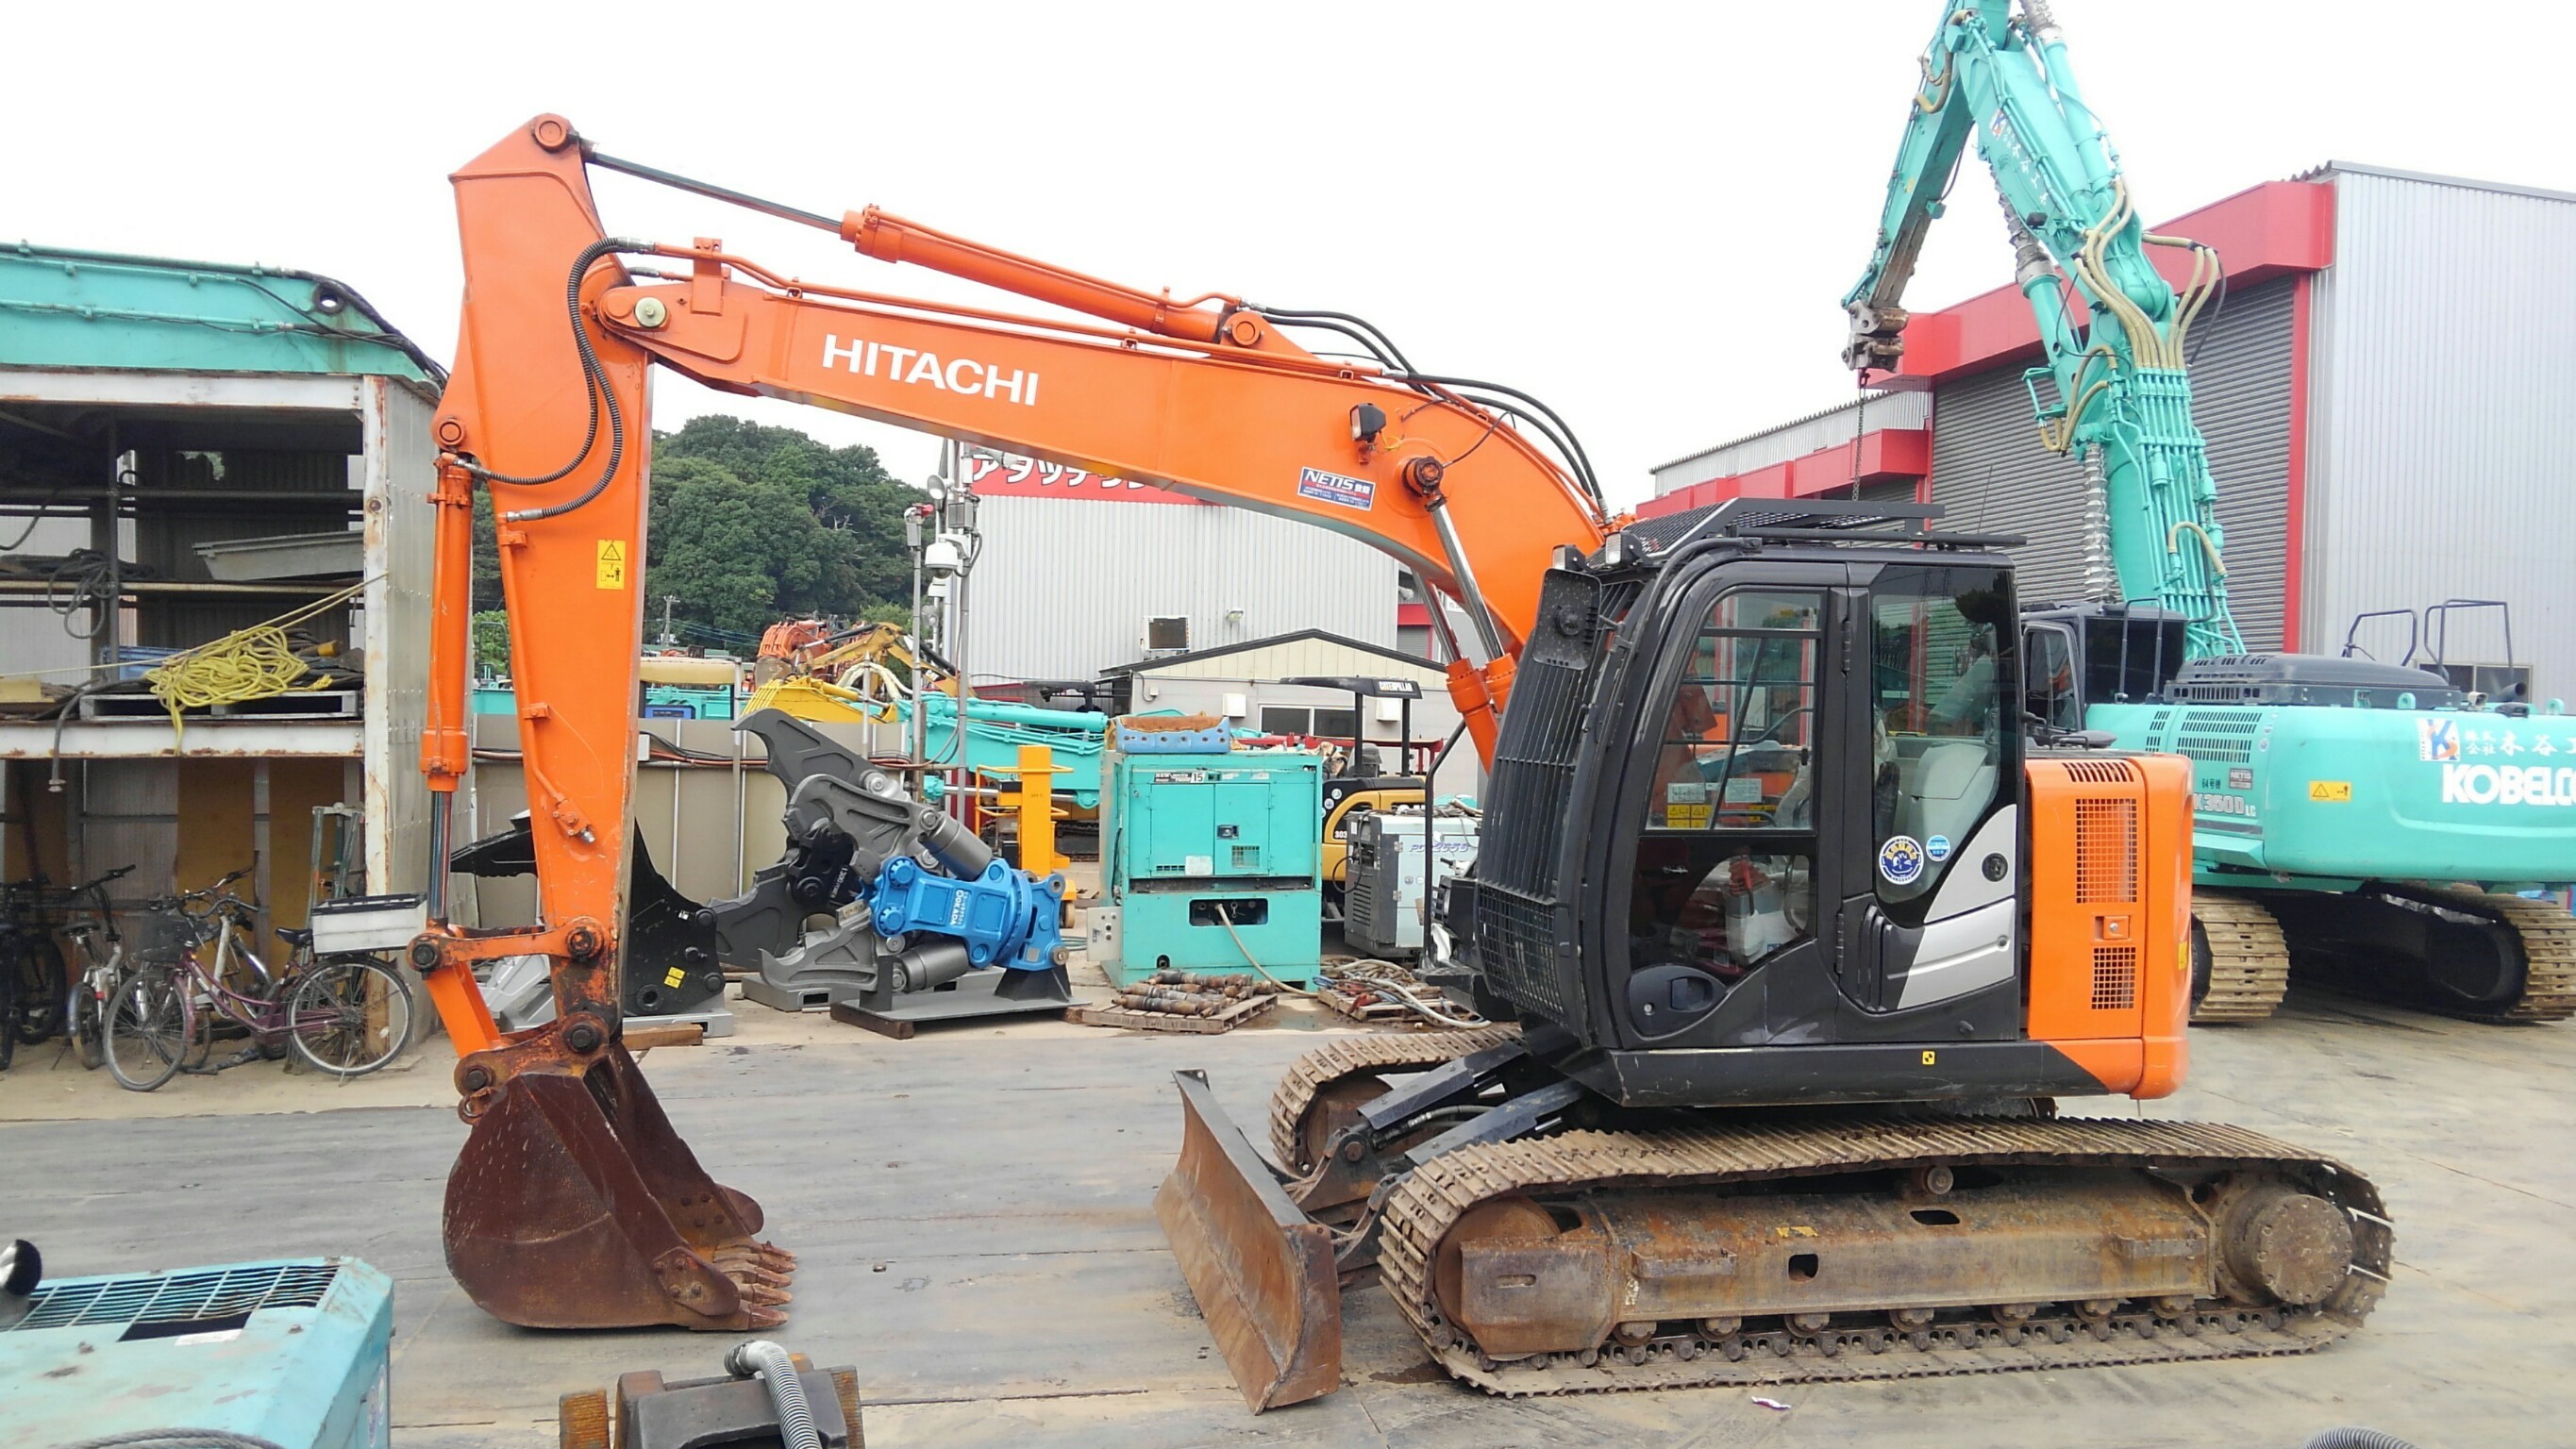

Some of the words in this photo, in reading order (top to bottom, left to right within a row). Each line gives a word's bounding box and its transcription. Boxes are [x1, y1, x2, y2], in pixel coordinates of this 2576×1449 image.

[822, 333, 1039, 407] HITACHI
[1304, 470, 1355, 491] NETIS
[1379, 680, 1413, 692] CATERPILLAR
[1194, 773, 1203, 782] 15
